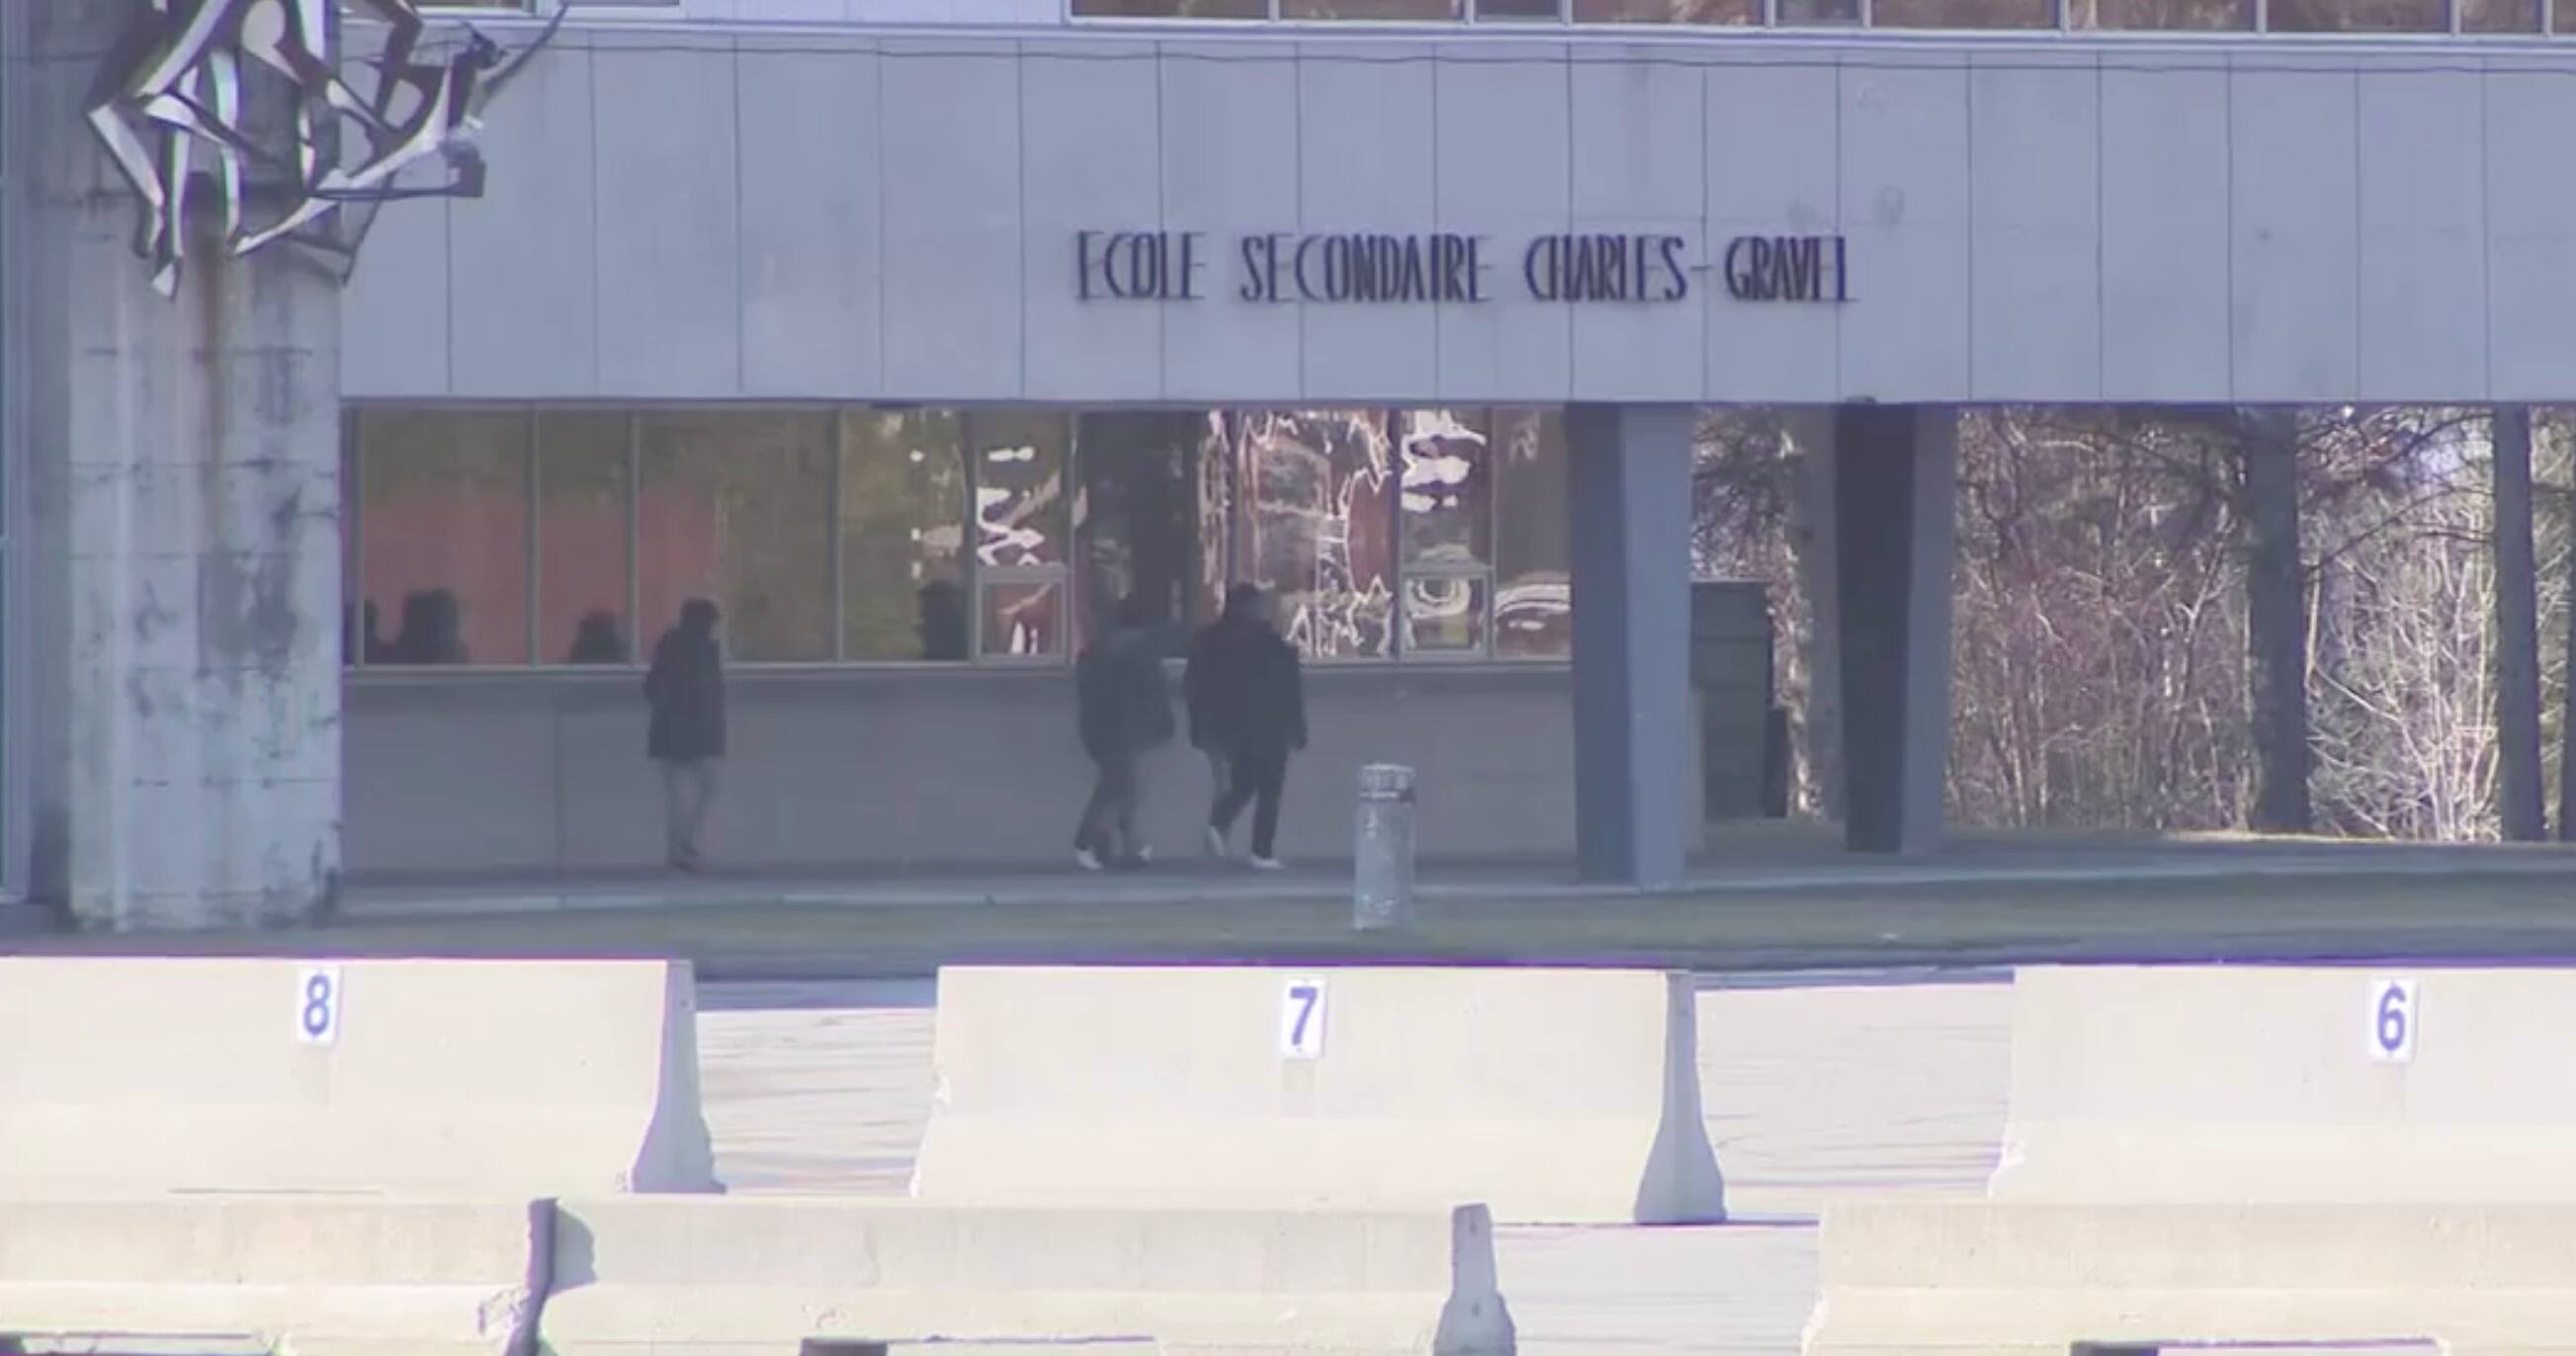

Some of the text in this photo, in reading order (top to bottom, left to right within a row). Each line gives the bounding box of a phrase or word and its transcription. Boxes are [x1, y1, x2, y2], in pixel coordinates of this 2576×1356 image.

[1077, 230, 1206, 300] ECOLE
[1240, 232, 1494, 302] SECONDAIRE
[304, 975, 330, 1036] 8
[1290, 986, 1318, 1046] 7
[2377, 984, 2406, 1051] 6
